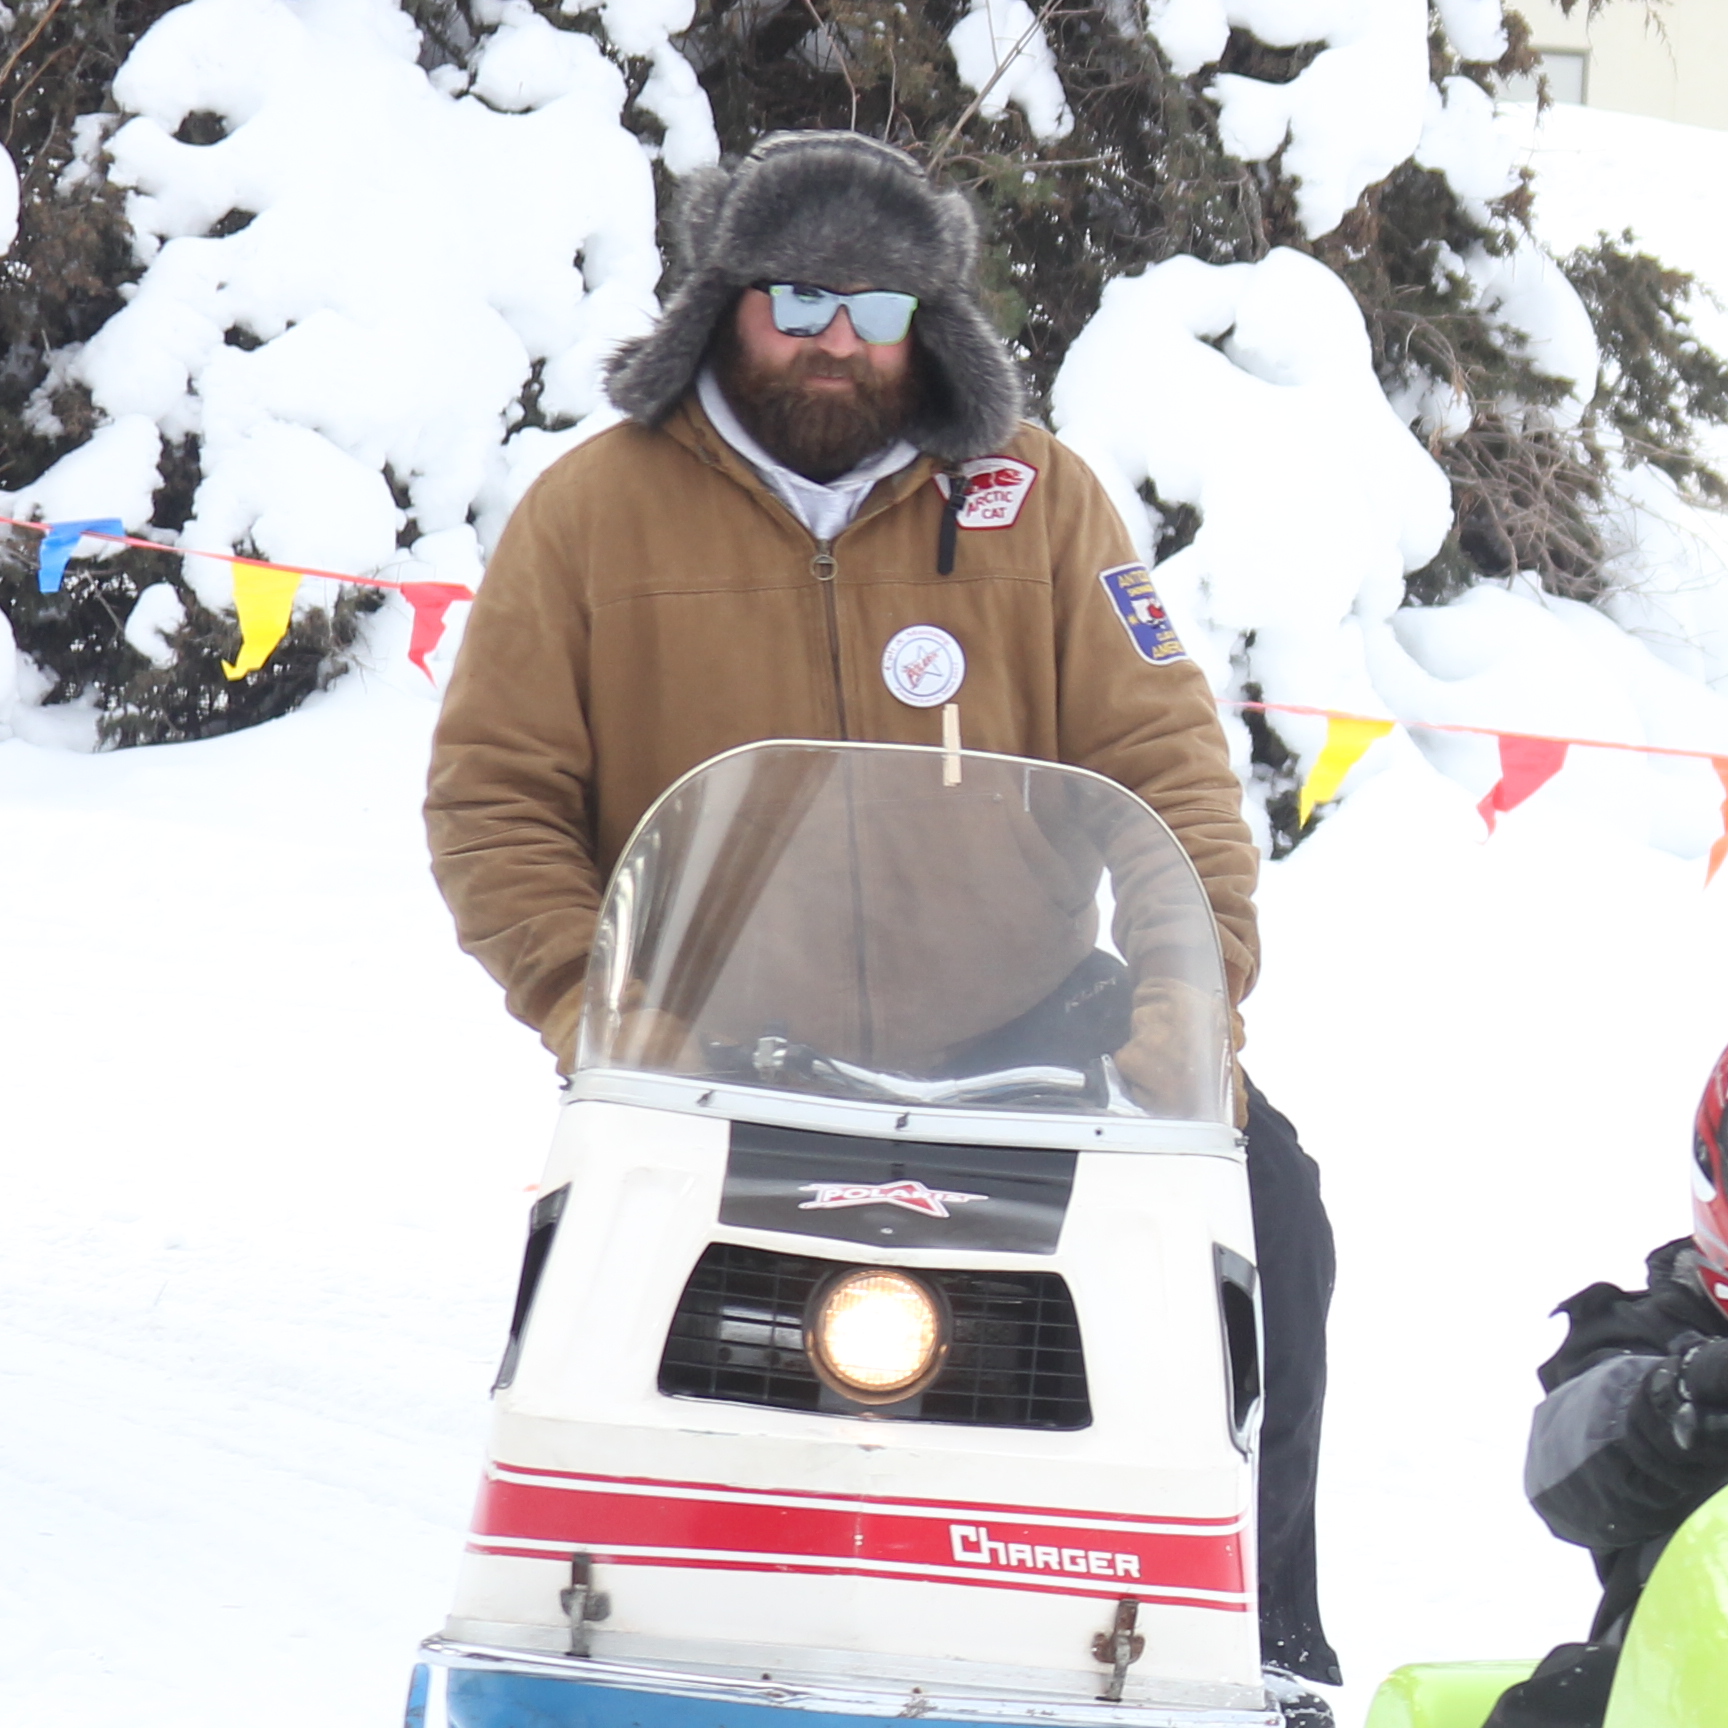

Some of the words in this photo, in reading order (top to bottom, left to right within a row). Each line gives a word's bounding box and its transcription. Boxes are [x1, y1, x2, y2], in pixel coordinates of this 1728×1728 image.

[966, 490, 1014, 518] ARCTIC
[981, 506, 1008, 519] CAT
[822, 1187, 968, 1203] POLARIS
